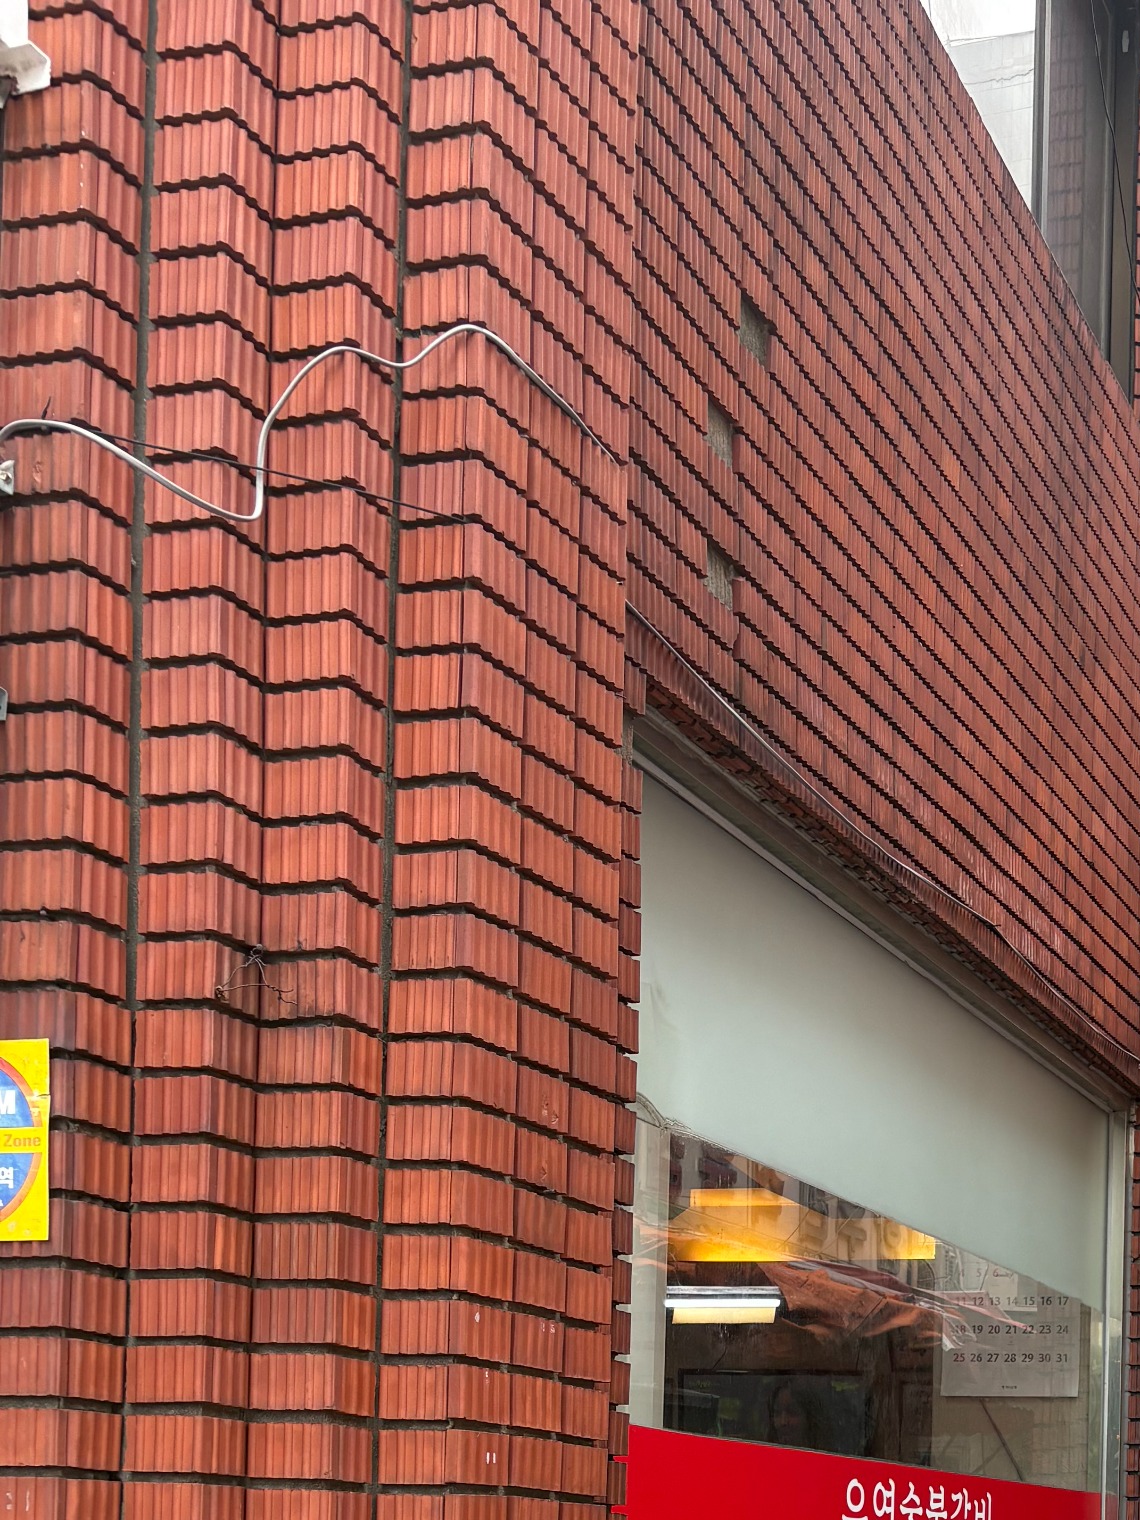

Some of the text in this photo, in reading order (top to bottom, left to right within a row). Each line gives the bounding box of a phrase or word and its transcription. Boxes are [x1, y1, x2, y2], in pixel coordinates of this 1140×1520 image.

[3, 1133, 41, 1147] Zone
[973, 1297, 984, 1306] 12
[990, 1297, 1000, 1306] 13
[1007, 1297, 1018, 1306] 14
[1024, 1297, 1035, 1306] 15
[1041, 1297, 1052, 1306] 16
[1058, 1297, 1069, 1306] 17
[972, 1325, 983, 1334] 19
[988, 1325, 1000, 1334] 20
[1006, 1325, 1017, 1334] 21
[1022, 1325, 1034, 1334] 22
[1039, 1325, 1051, 1334] 23
[1057, 1325, 1068, 1334] 24
[953, 1353, 1068, 1363] 25 26 27 28 29 30 31
